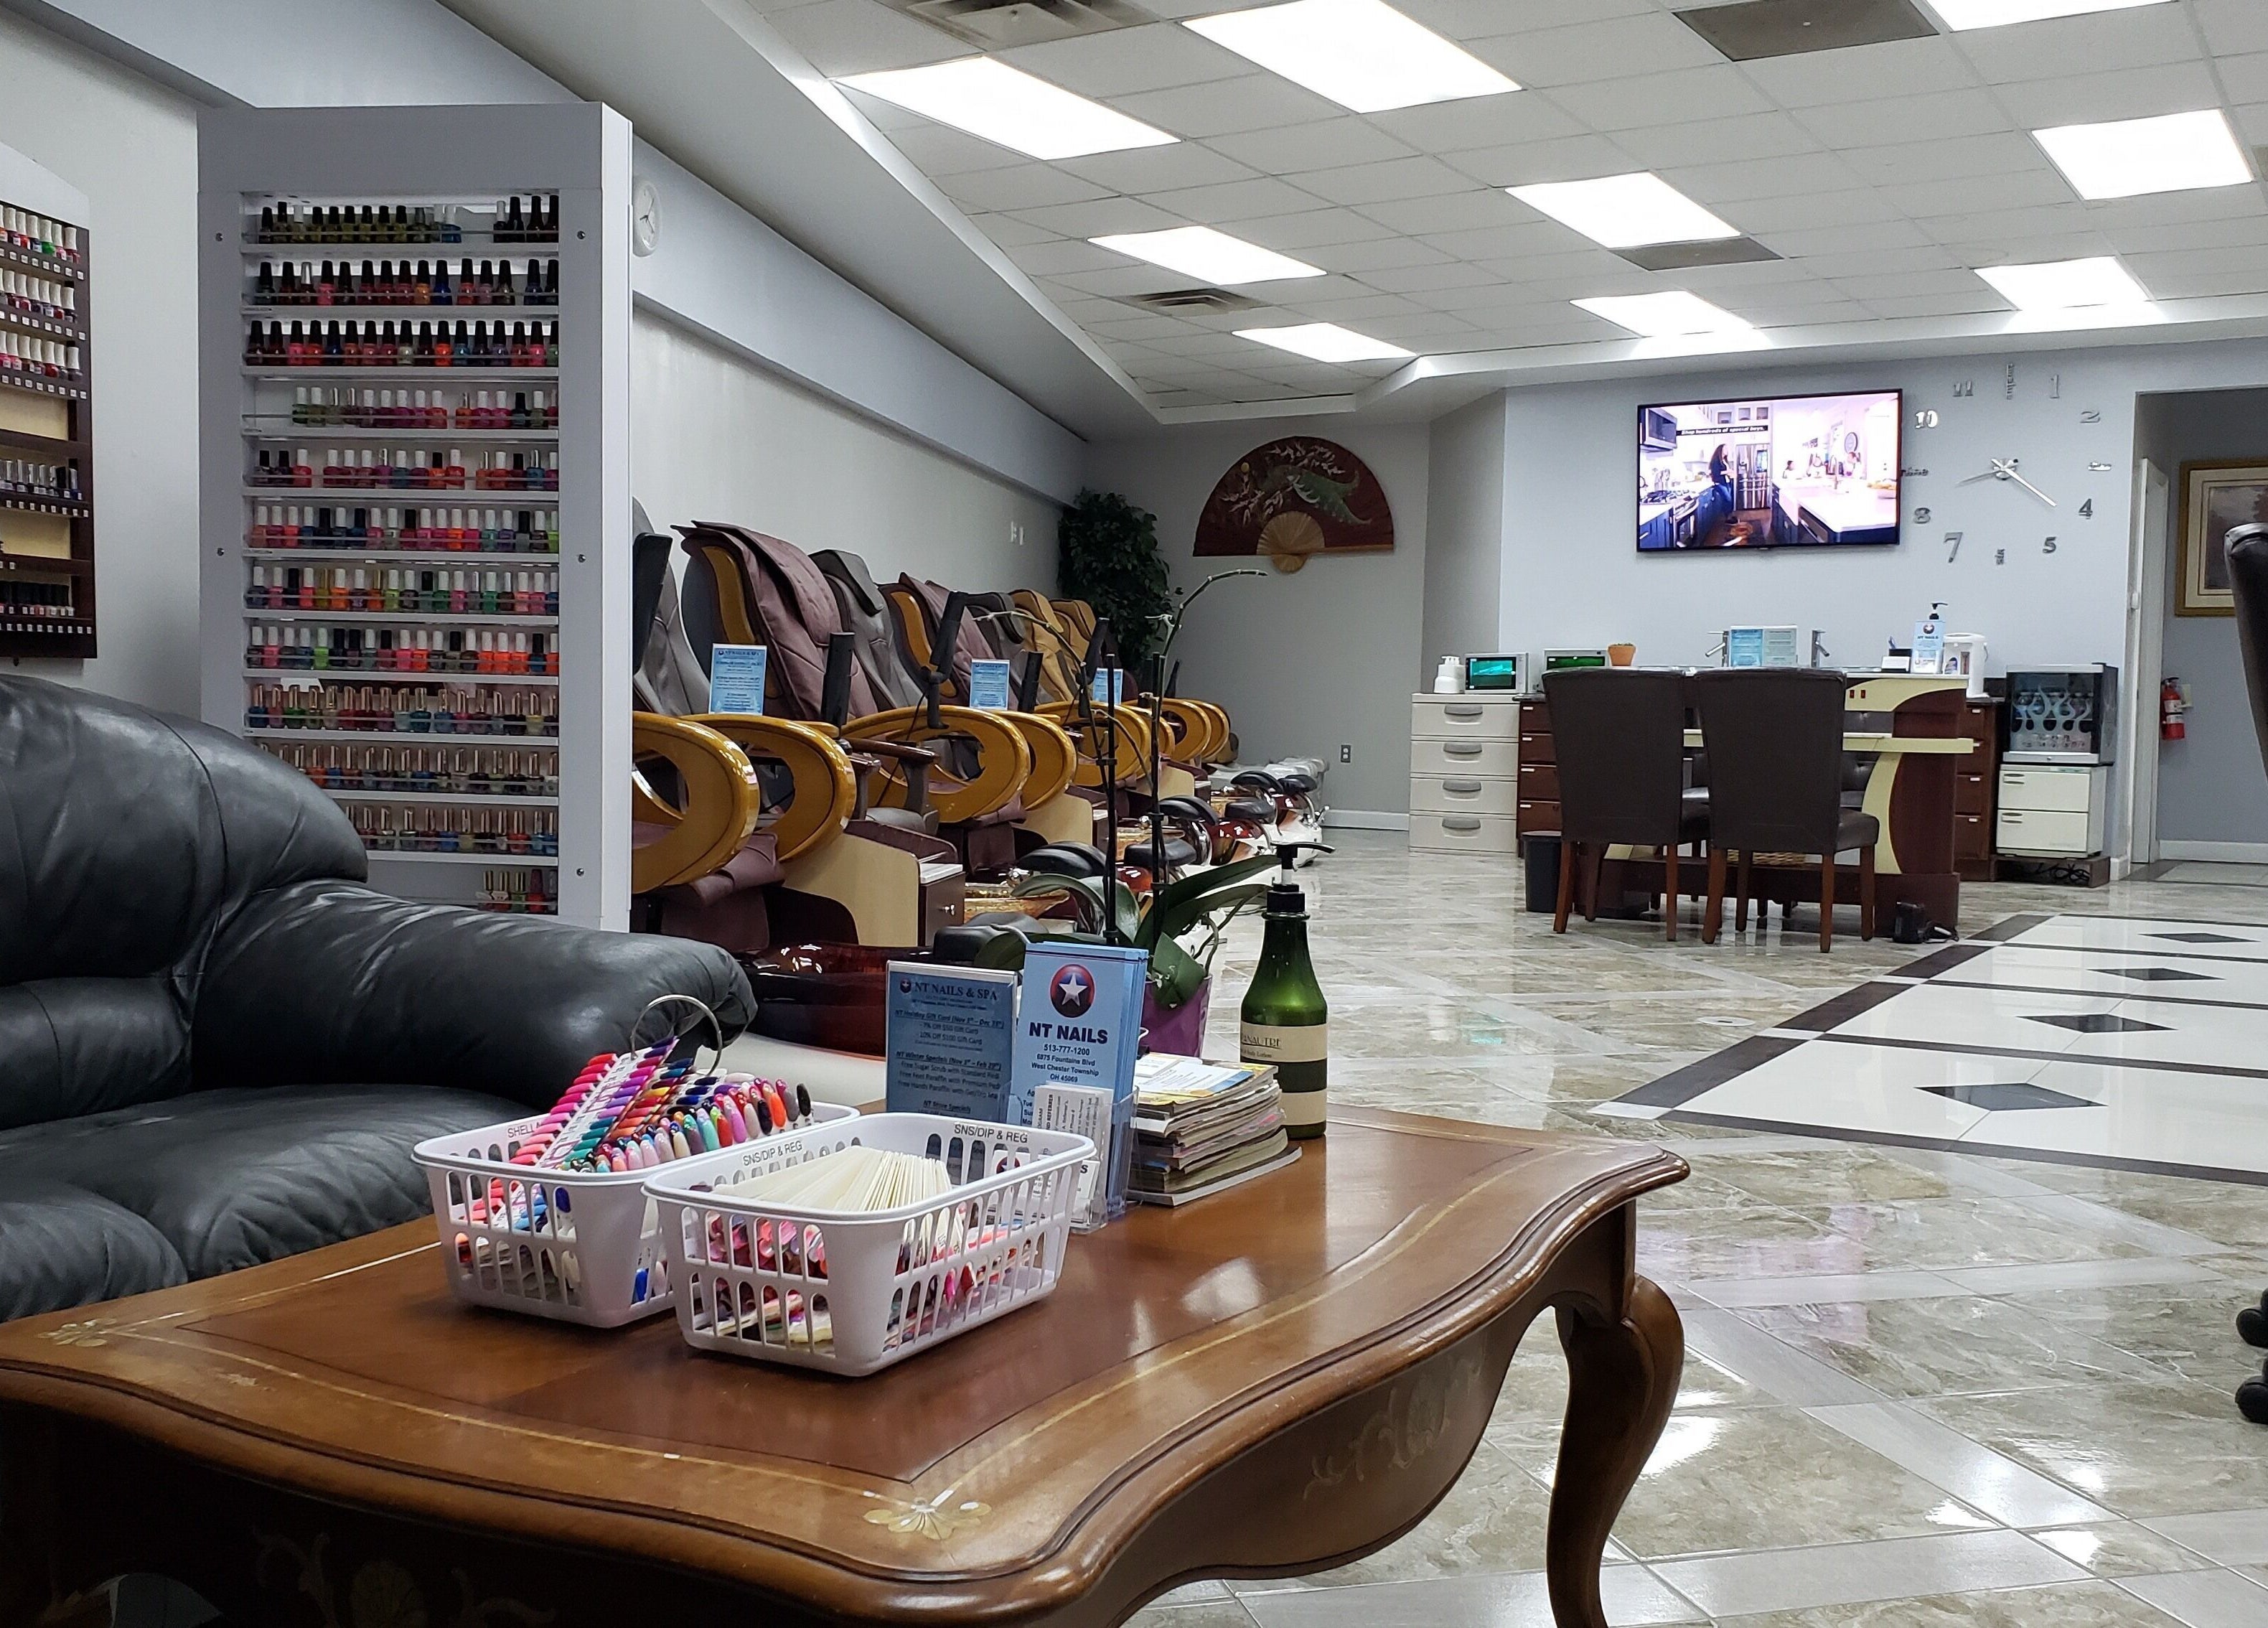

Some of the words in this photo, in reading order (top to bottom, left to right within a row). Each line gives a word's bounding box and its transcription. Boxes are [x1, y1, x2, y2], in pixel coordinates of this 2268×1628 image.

[1953, 380, 1973, 397] 11
[2049, 374, 2060, 399] 1
[1914, 409, 1938, 429] 10
[2079, 410, 2101, 424] 2
[1913, 507, 1931, 524] 8
[2078, 498, 2094, 519] 4
[1943, 531, 1963, 563] 7
[2042, 536, 2057, 554] 5
[914, 981, 930, 993] NT
[932, 983, 963, 996] NAILS
[966, 988, 975, 998] &
[978, 988, 998, 1001] SPA
[1028, 1021, 1053, 1038] NT
[1056, 1025, 1108, 1044] NAILS
[1044, 1044, 1090, 1056] 513-777-1200
[1051, 1054, 1080, 1065] Fountains
[1070, 1067, 1100, 1077] Township
[954, 1123, 995, 1138] SNS/DIP
[996, 1130, 1003, 1140] &
[1006, 1131, 1028, 1143] REG
[743, 1149, 777, 1166] SNS/DIP
[777, 1147, 784, 1156] &
[784, 1141, 803, 1155] REG
